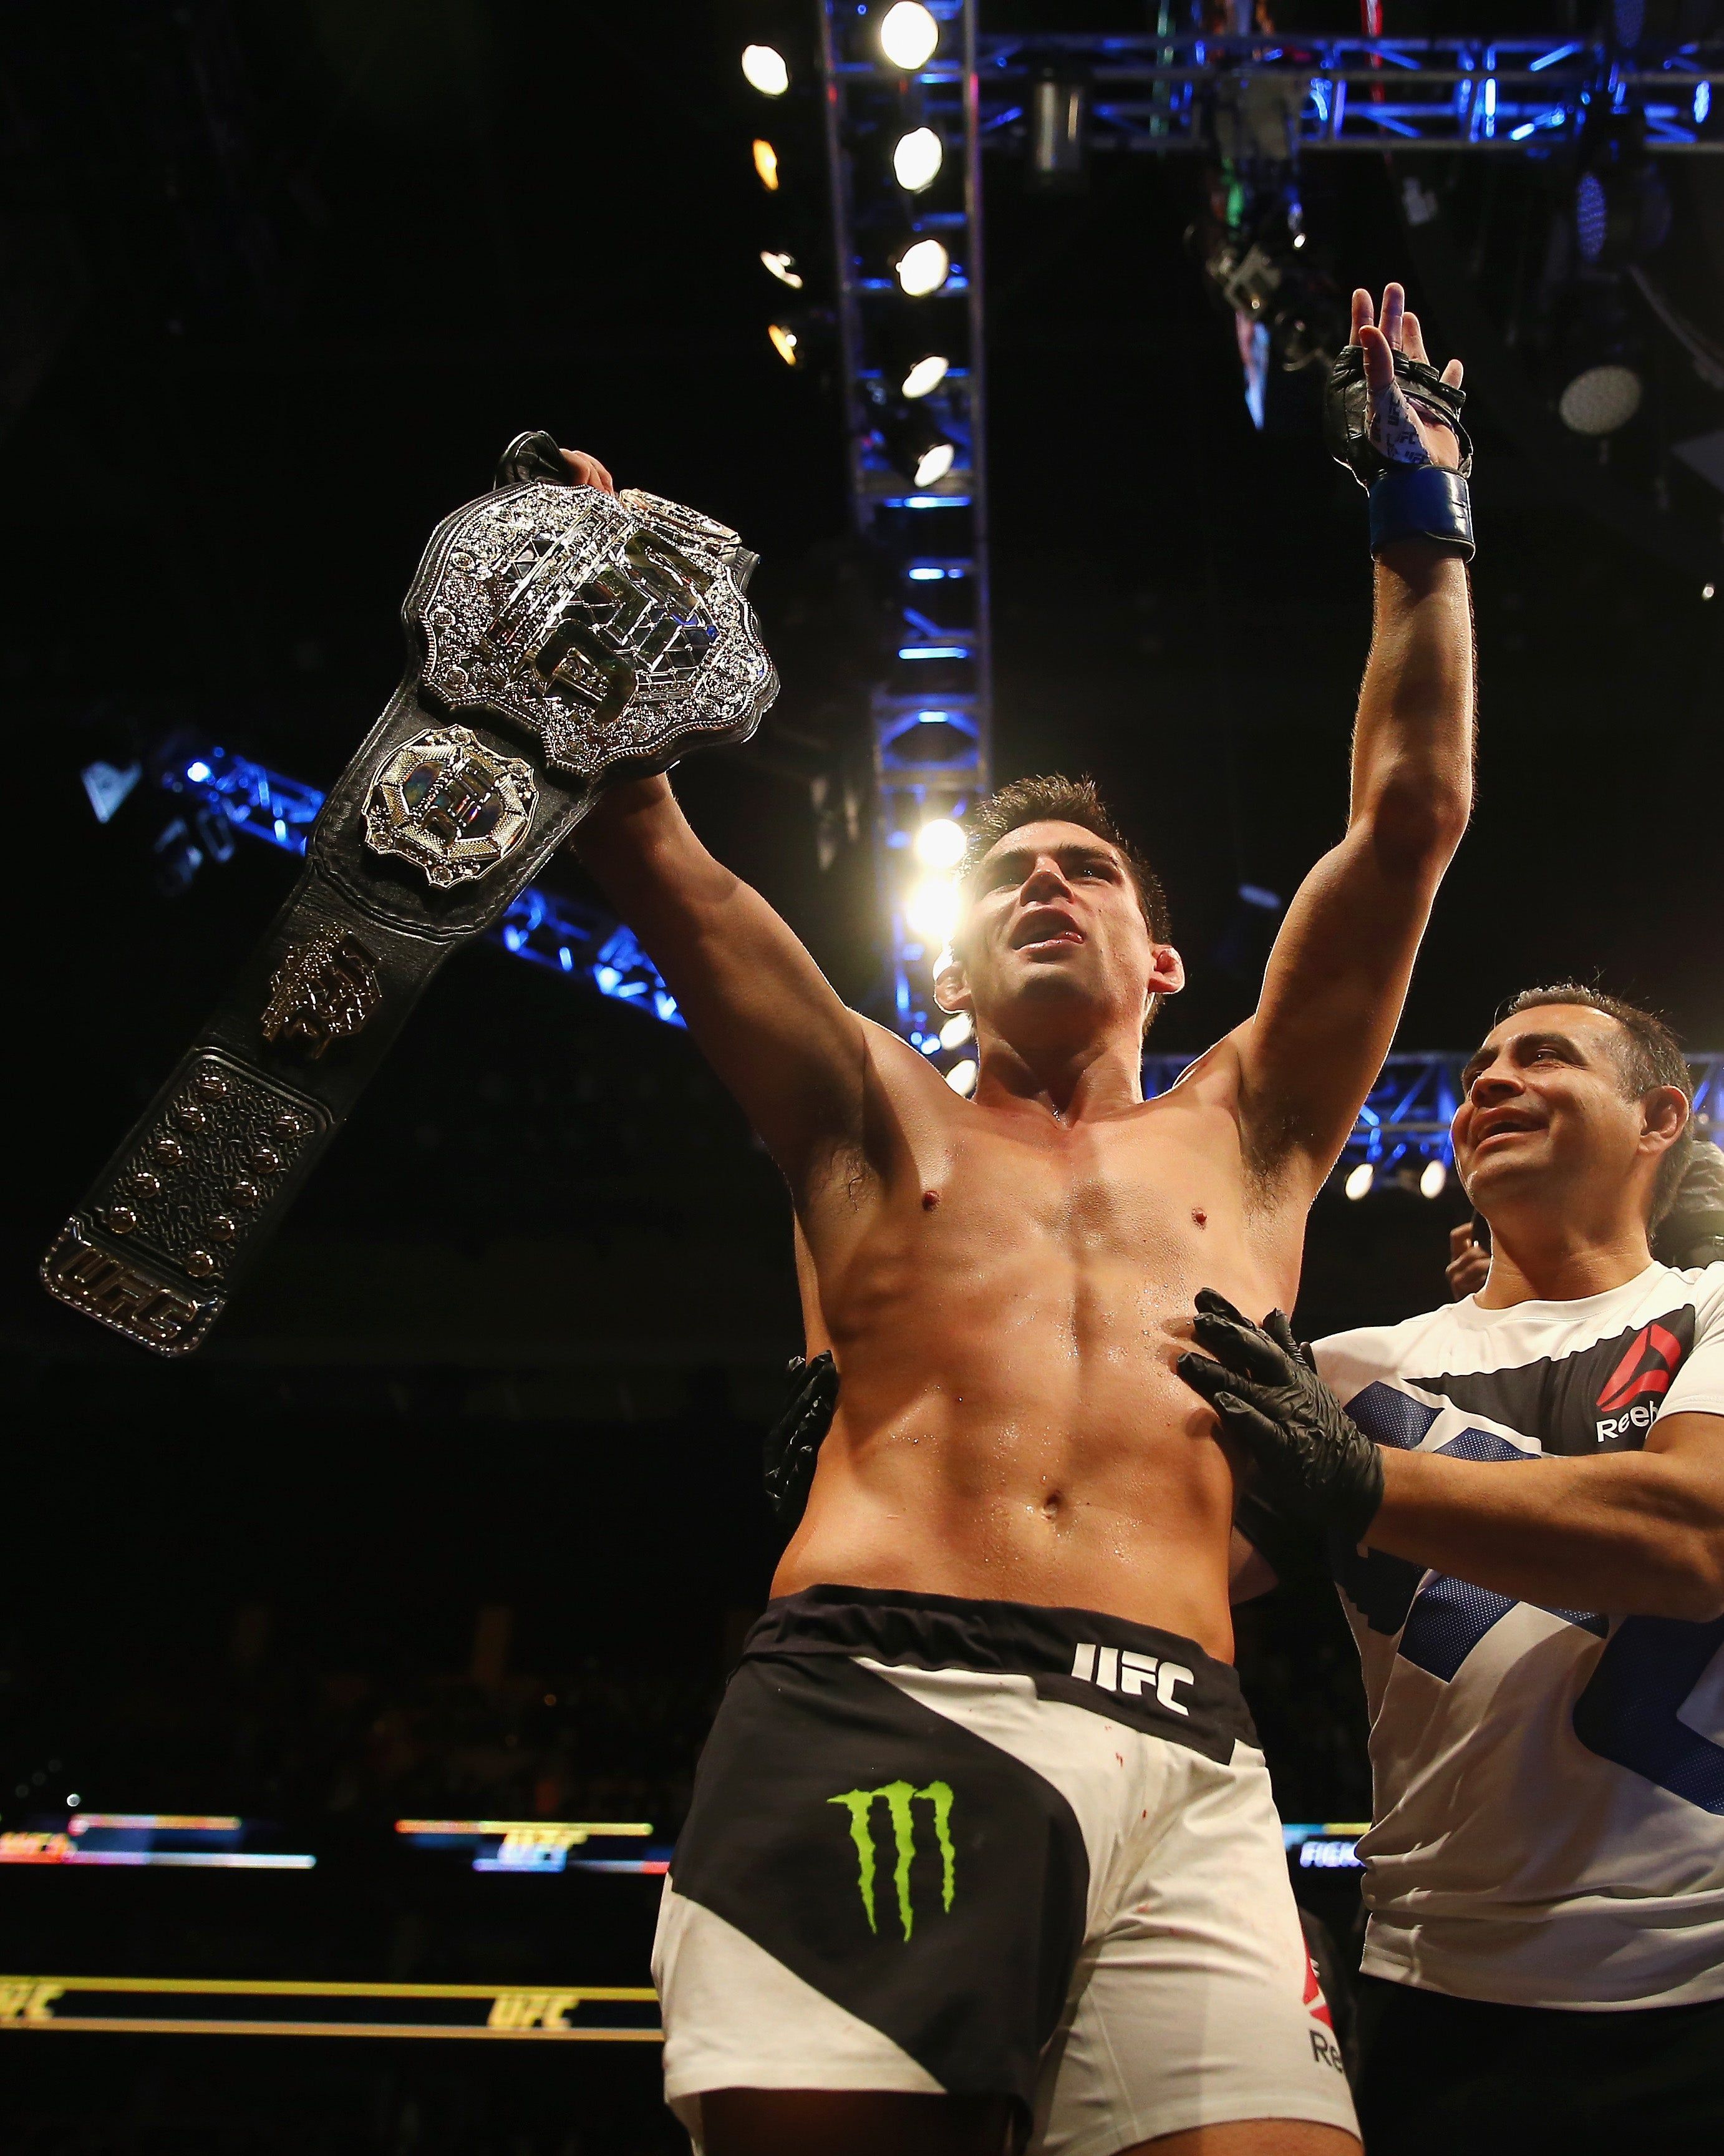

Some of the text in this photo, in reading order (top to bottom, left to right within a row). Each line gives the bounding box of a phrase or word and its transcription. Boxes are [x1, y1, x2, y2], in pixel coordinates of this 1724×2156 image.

[1397, 432, 1416, 444] FC
[533, 527, 717, 725] UFC
[58, 1246, 196, 1340] UFC
[1071, 1643, 1194, 1716] UFC
[0, 1983, 65, 2022] FC
[487, 1994, 580, 2031] UFC
